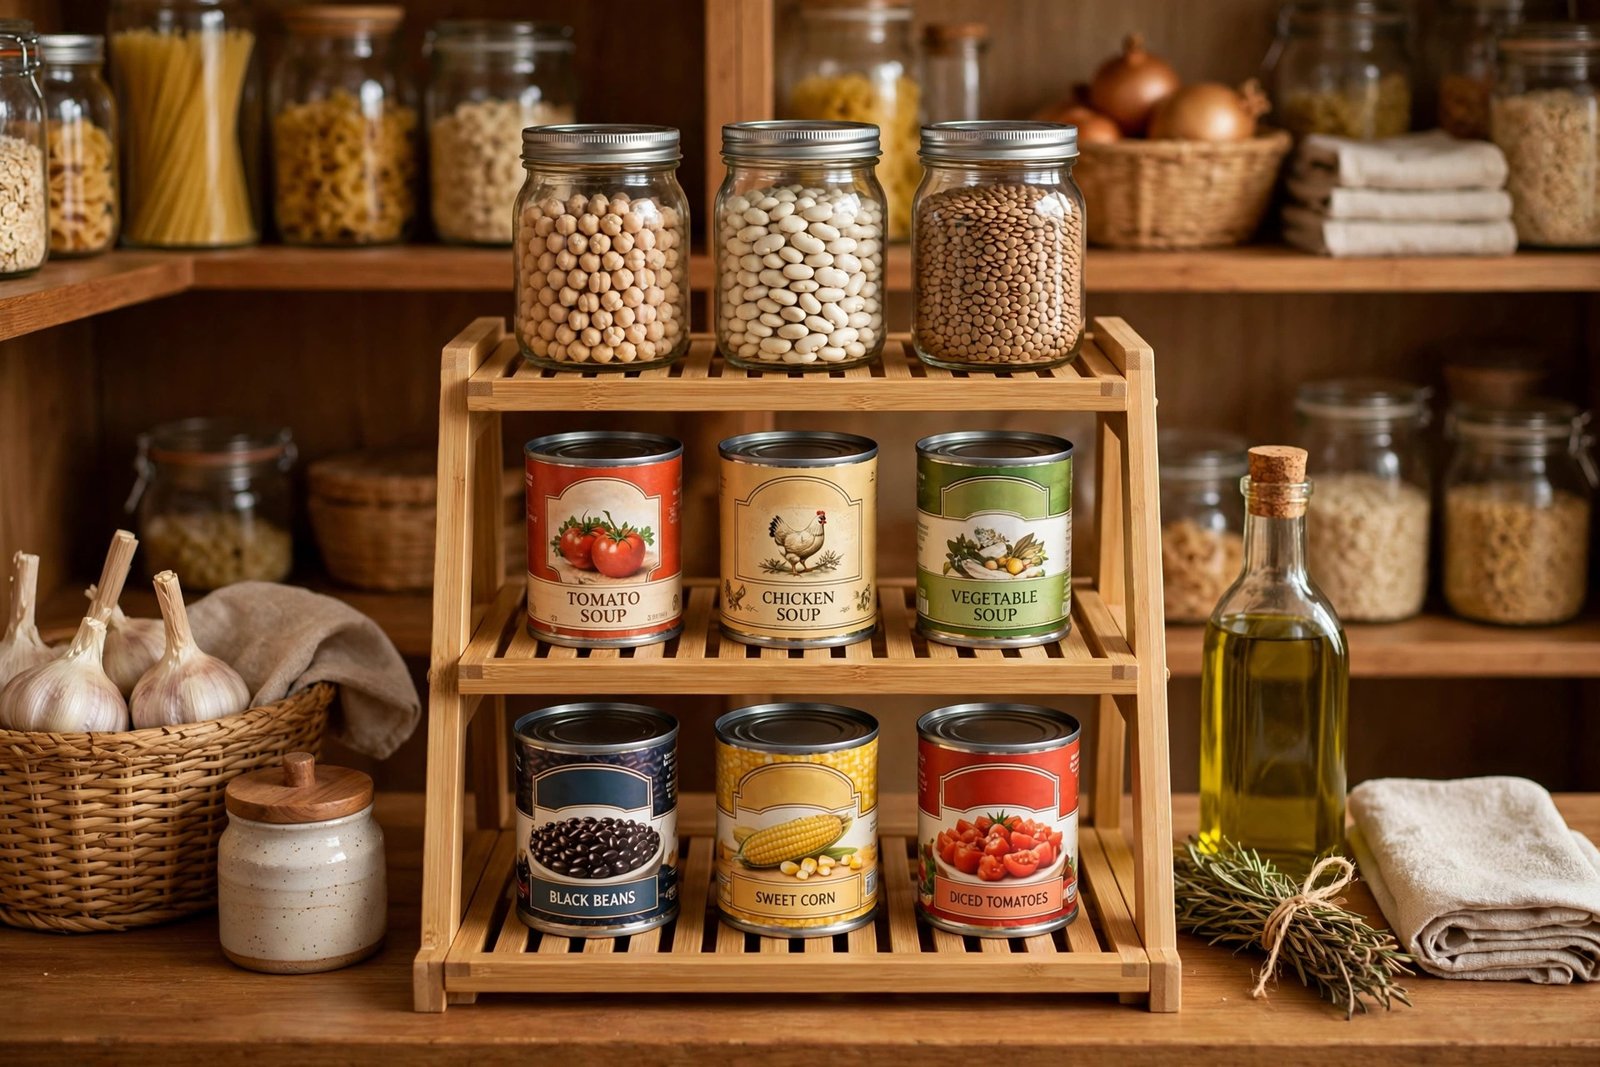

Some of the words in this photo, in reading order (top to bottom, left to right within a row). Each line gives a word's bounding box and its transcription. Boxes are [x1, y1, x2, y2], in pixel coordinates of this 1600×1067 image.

[567, 591, 640, 606] TOMATO
[762, 591, 835, 605] CHICKEN
[951, 589, 1038, 605] VEGETABLE
[580, 608, 627, 623] SOUP
[776, 608, 821, 621] SOUP
[974, 608, 1017, 621] SOUP
[550, 890, 589, 906] BLACK
[593, 891, 636, 907] BEANS
[755, 891, 796, 906] SWEET
[800, 892, 836, 906] CORN
[950, 890, 983, 907] DICED
[986, 891, 1048, 908] TOMATOES
